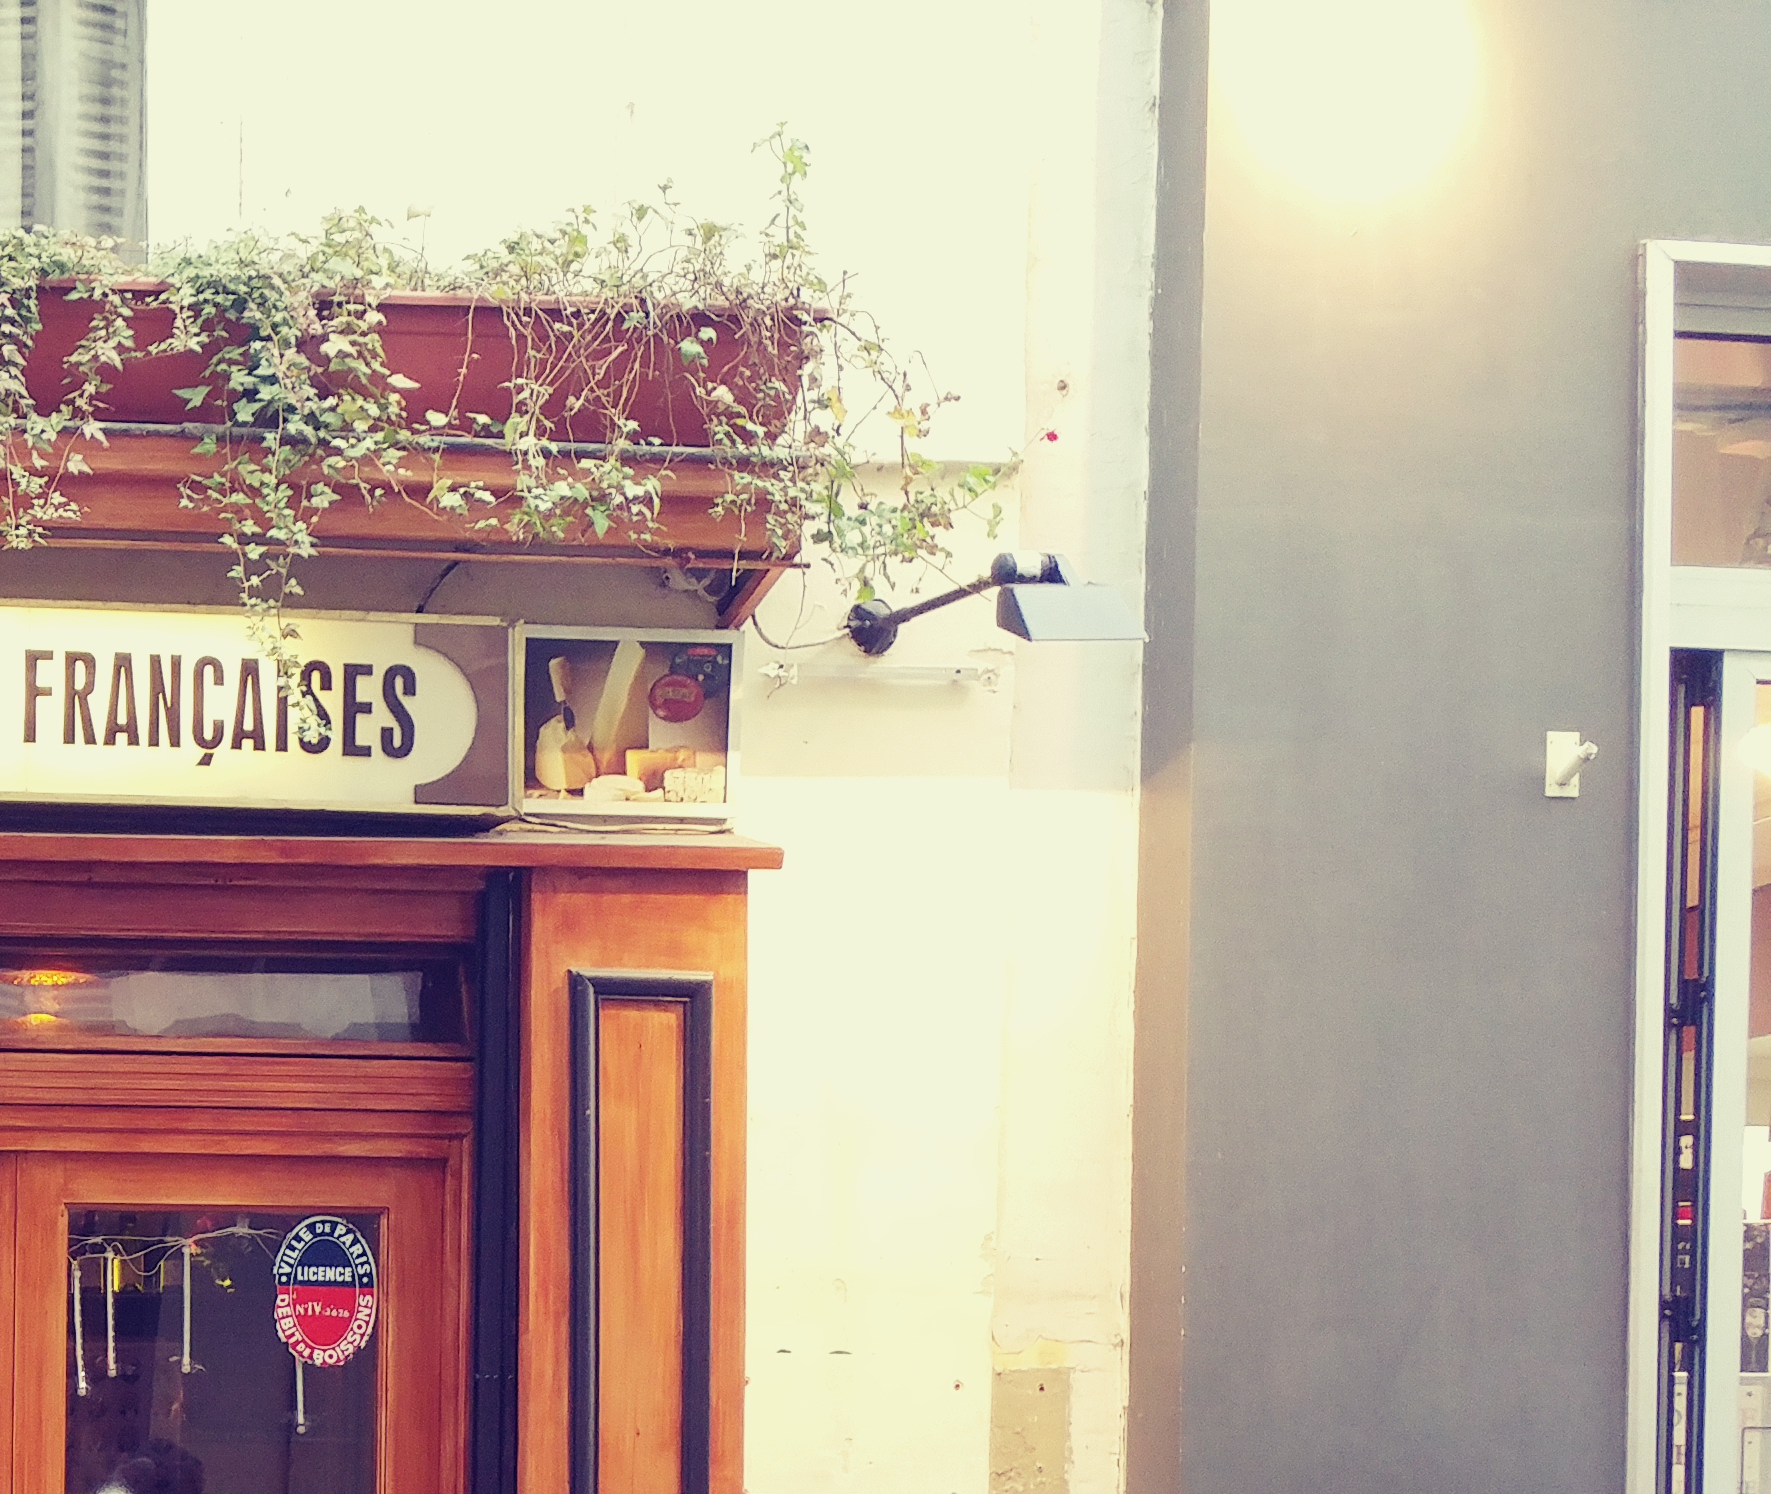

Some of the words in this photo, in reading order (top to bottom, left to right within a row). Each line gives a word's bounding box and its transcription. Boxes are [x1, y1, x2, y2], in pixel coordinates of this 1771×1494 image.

[23, 648, 416, 768] FRANÇAISES
[278, 1228, 313, 1274] VILLE
[316, 1223, 331, 1233] DE
[334, 1224, 371, 1274] PARIS
[297, 1266, 353, 1281] LICENCE
[277, 1294, 302, 1345] DEBIT
[313, 1295, 372, 1364] BOISSONS
